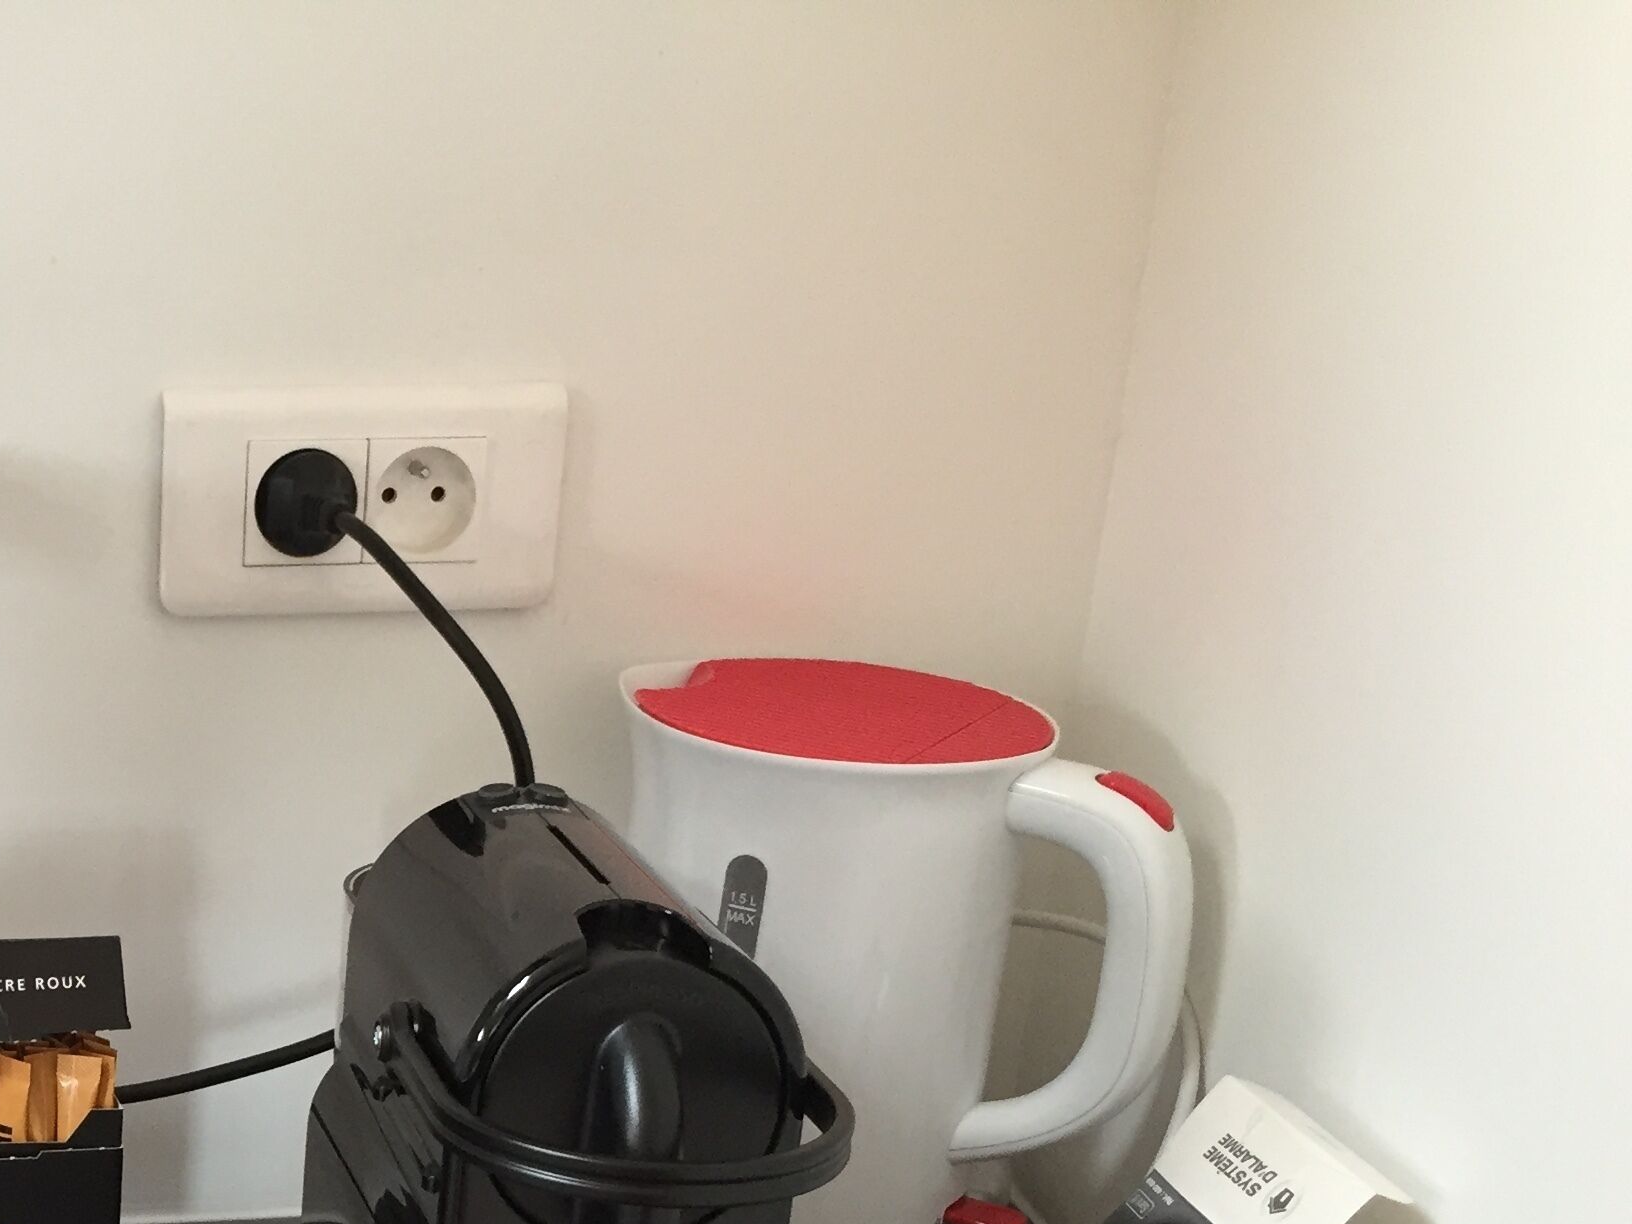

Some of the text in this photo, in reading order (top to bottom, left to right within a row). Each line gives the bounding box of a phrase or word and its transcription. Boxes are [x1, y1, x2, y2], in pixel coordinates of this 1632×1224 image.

[751, 896, 757, 906] L
[727, 909, 756, 925] MAX
[35, 975, 87, 990] ROUX
[1218, 1133, 1278, 1183] D'ALARME
[1203, 1145, 1262, 1197] SYSTÈME
